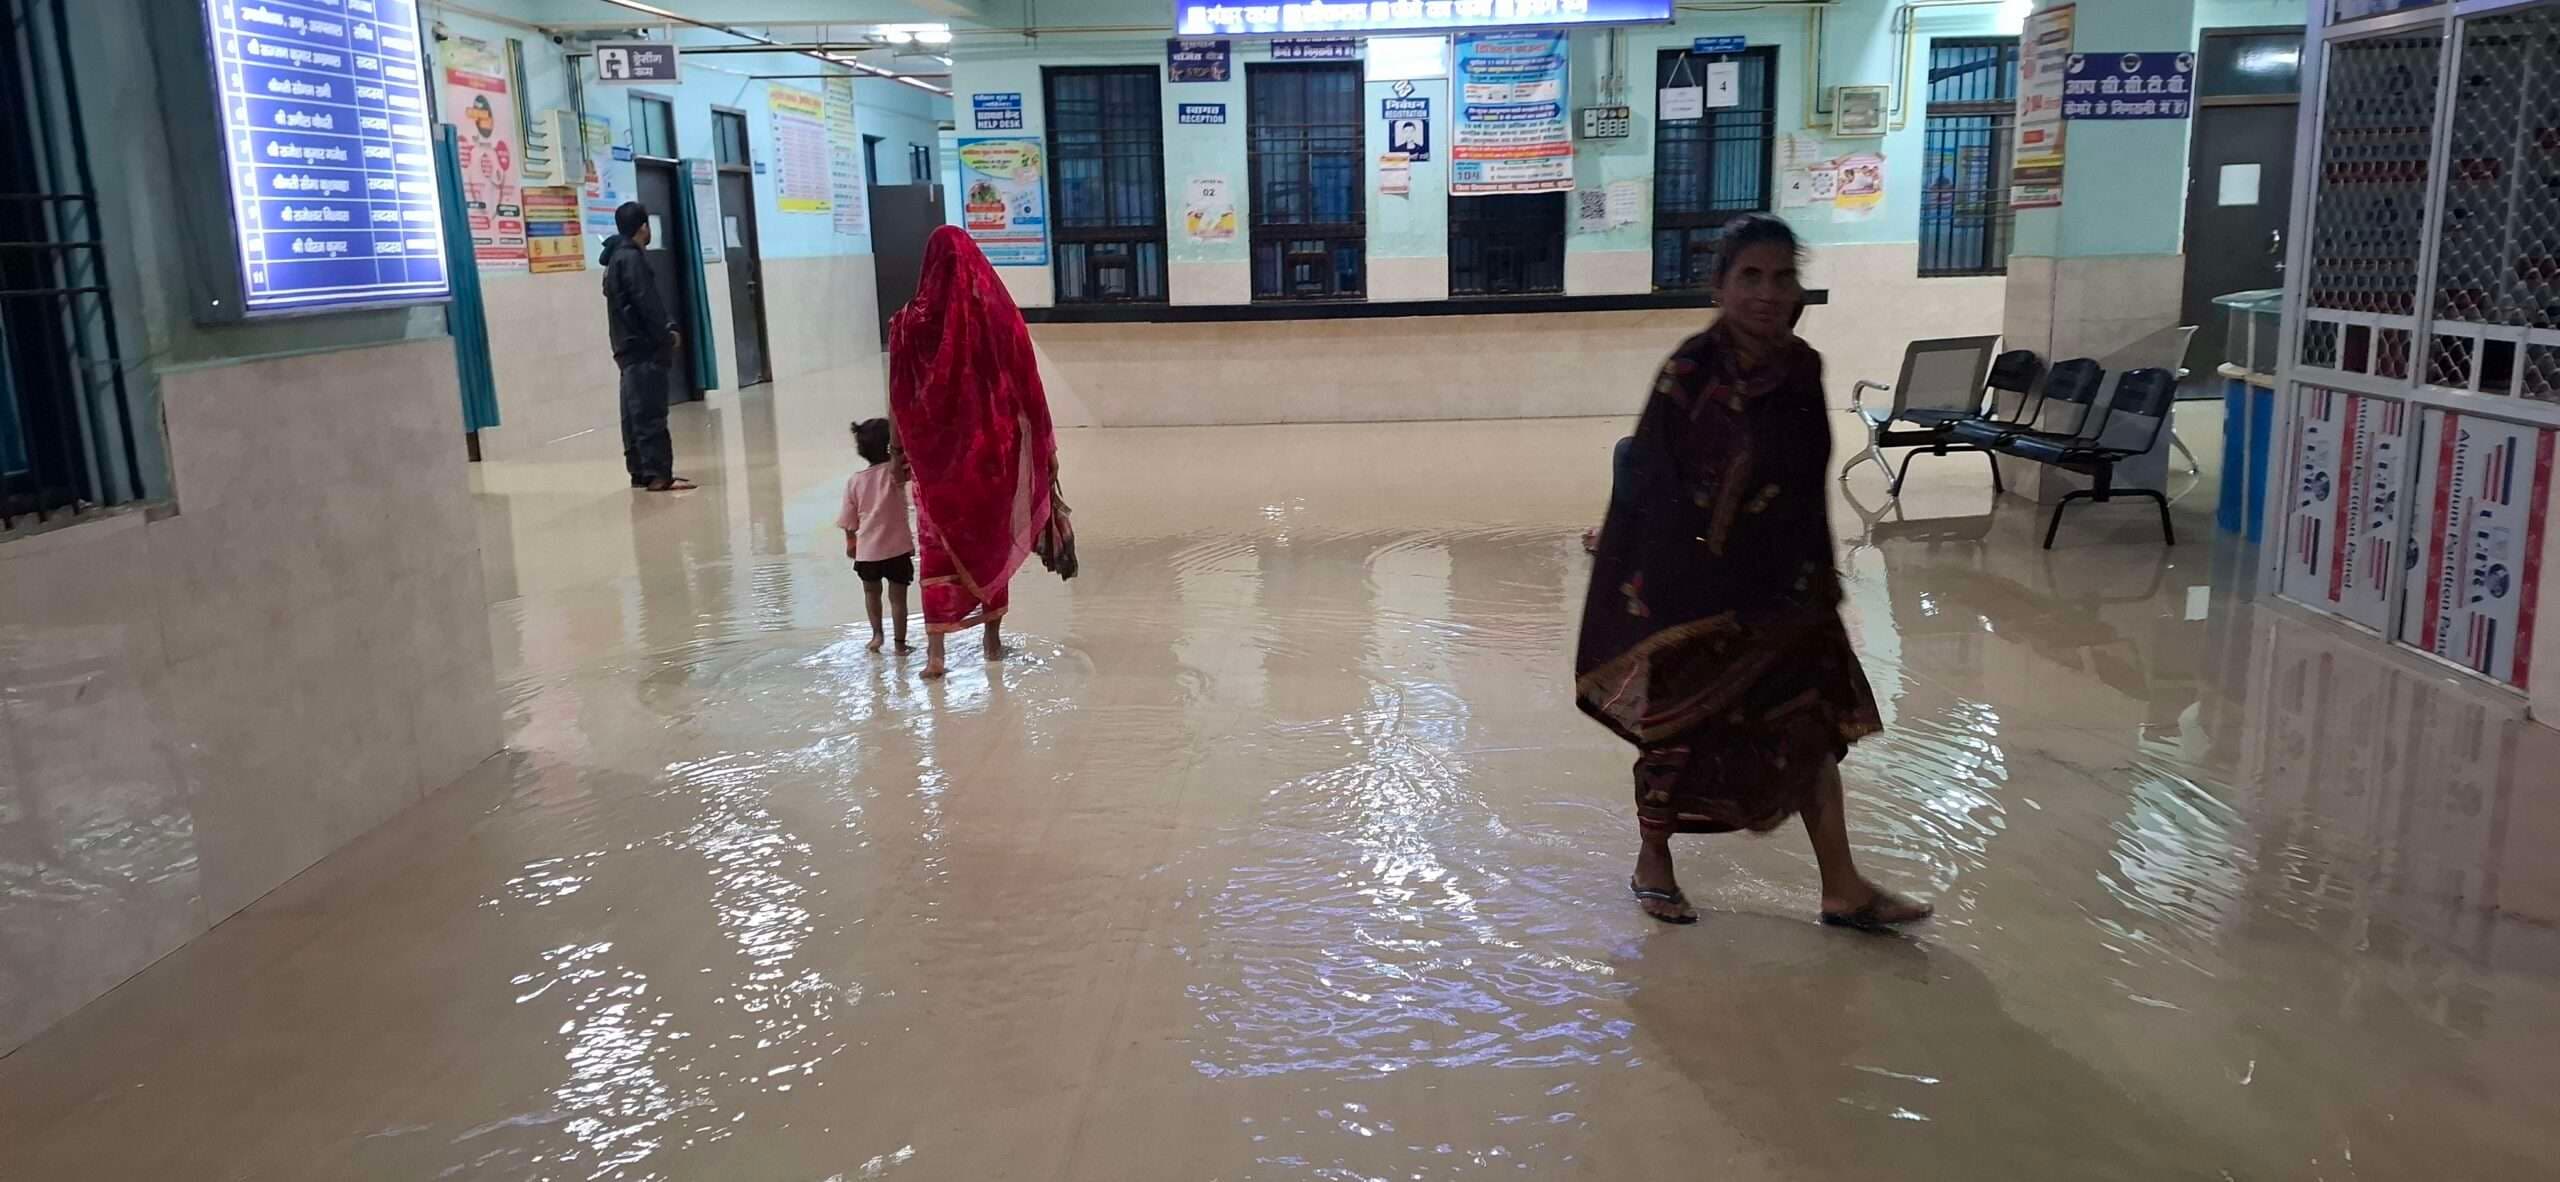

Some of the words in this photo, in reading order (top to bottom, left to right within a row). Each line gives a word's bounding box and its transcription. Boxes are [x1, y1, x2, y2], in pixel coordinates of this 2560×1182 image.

[2065, 79, 2097, 95] आप
[978, 120, 998, 129] HELP
[999, 119, 1021, 128] DESK
[1180, 115, 1224, 123] RECEPTION
[2343, 541, 2357, 589] Panel
[2441, 532, 2459, 610] Partition
